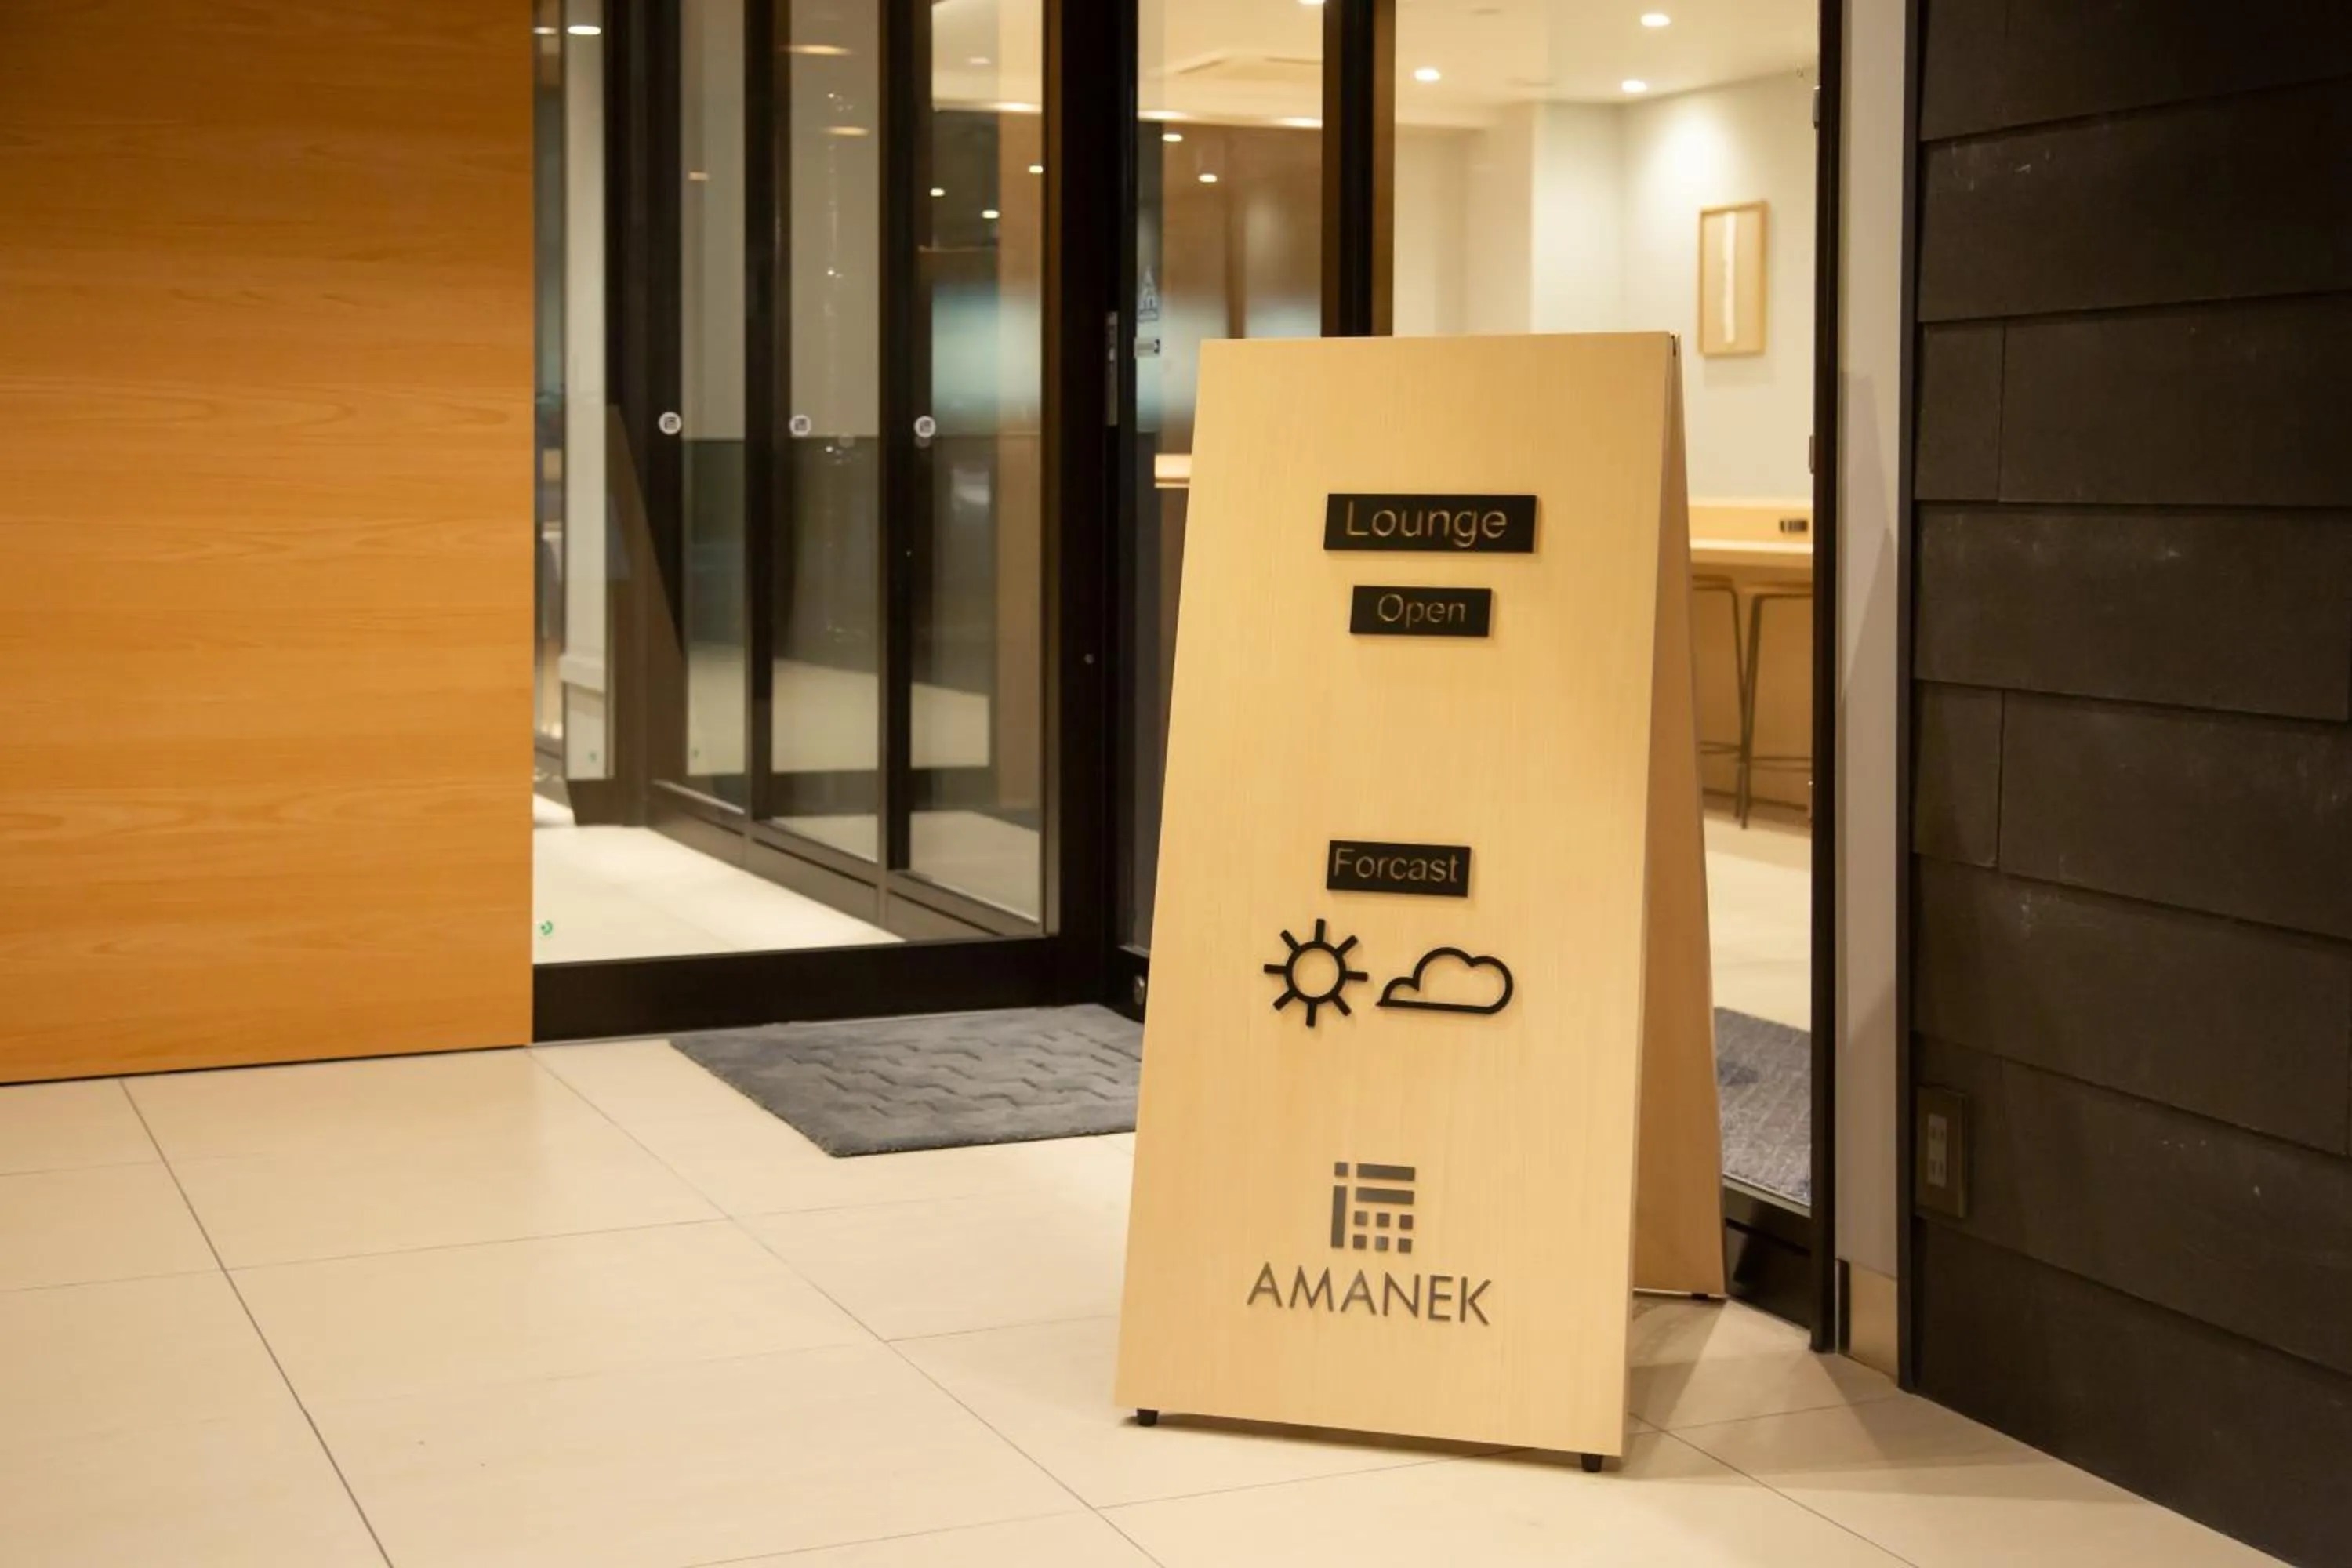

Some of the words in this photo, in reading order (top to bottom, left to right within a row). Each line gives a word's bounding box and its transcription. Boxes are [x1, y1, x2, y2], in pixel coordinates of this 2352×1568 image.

[1345, 500, 1508, 548] Lounge
[1377, 593, 1466, 627] Open
[1333, 848, 1460, 883] Forcast
[1247, 1261, 1491, 1326] AMANEK
